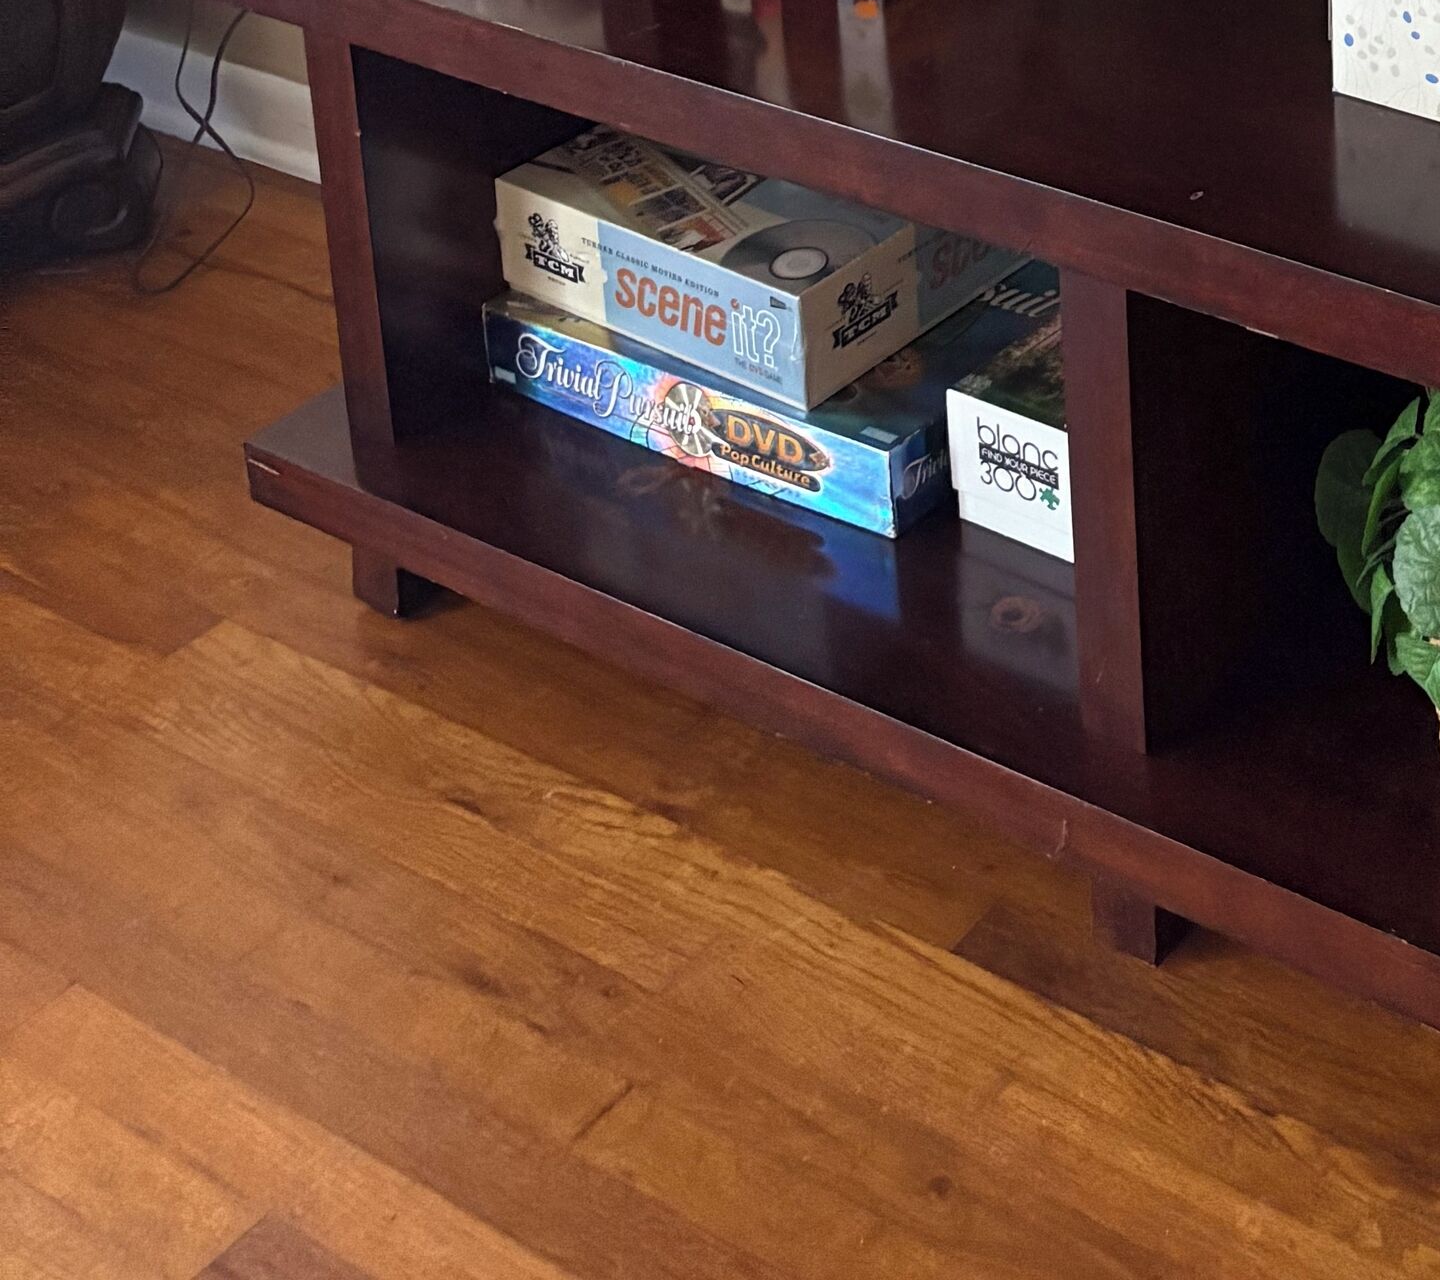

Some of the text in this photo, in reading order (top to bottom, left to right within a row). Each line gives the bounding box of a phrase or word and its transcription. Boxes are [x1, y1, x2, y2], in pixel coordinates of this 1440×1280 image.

[535, 254, 576, 279] TCM
[615, 249, 649, 269] CLASSIC
[650, 265, 683, 283] MOVIES
[684, 278, 720, 297] EDITION
[615, 267, 781, 370] scene it?
[843, 305, 887, 340] TCM
[516, 333, 694, 436] Trivial Pursuit
[726, 414, 804, 465] DVD
[976, 415, 1059, 472] blanc
[719, 443, 750, 468] Pop
[751, 454, 810, 488] Culture
[980, 459, 1037, 502] 300
[981, 447, 1057, 485] FIND YOUR PIECE
